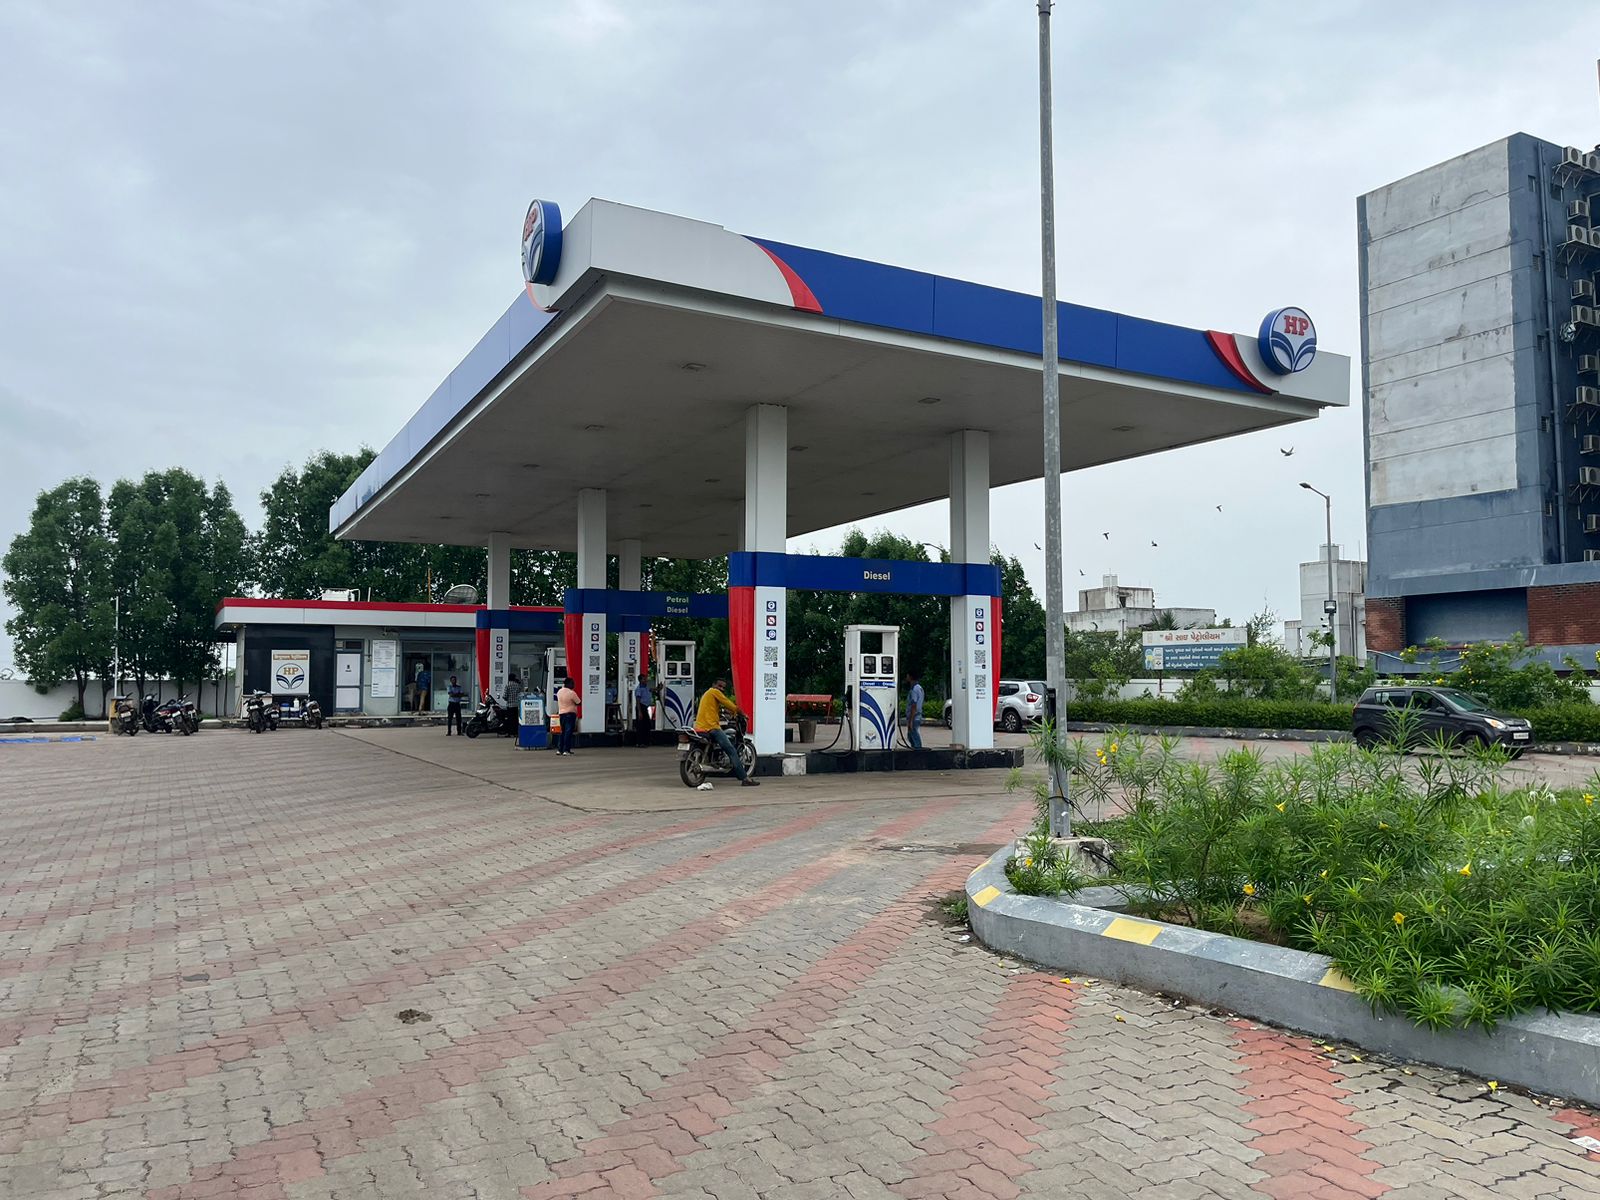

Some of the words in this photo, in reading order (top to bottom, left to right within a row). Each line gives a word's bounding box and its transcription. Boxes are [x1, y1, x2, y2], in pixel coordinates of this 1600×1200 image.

[1283, 315, 1309, 336] HP
[863, 570, 891, 581] Diesel
[666, 606, 689, 614] Diesel
[283, 667, 299, 675] HP
